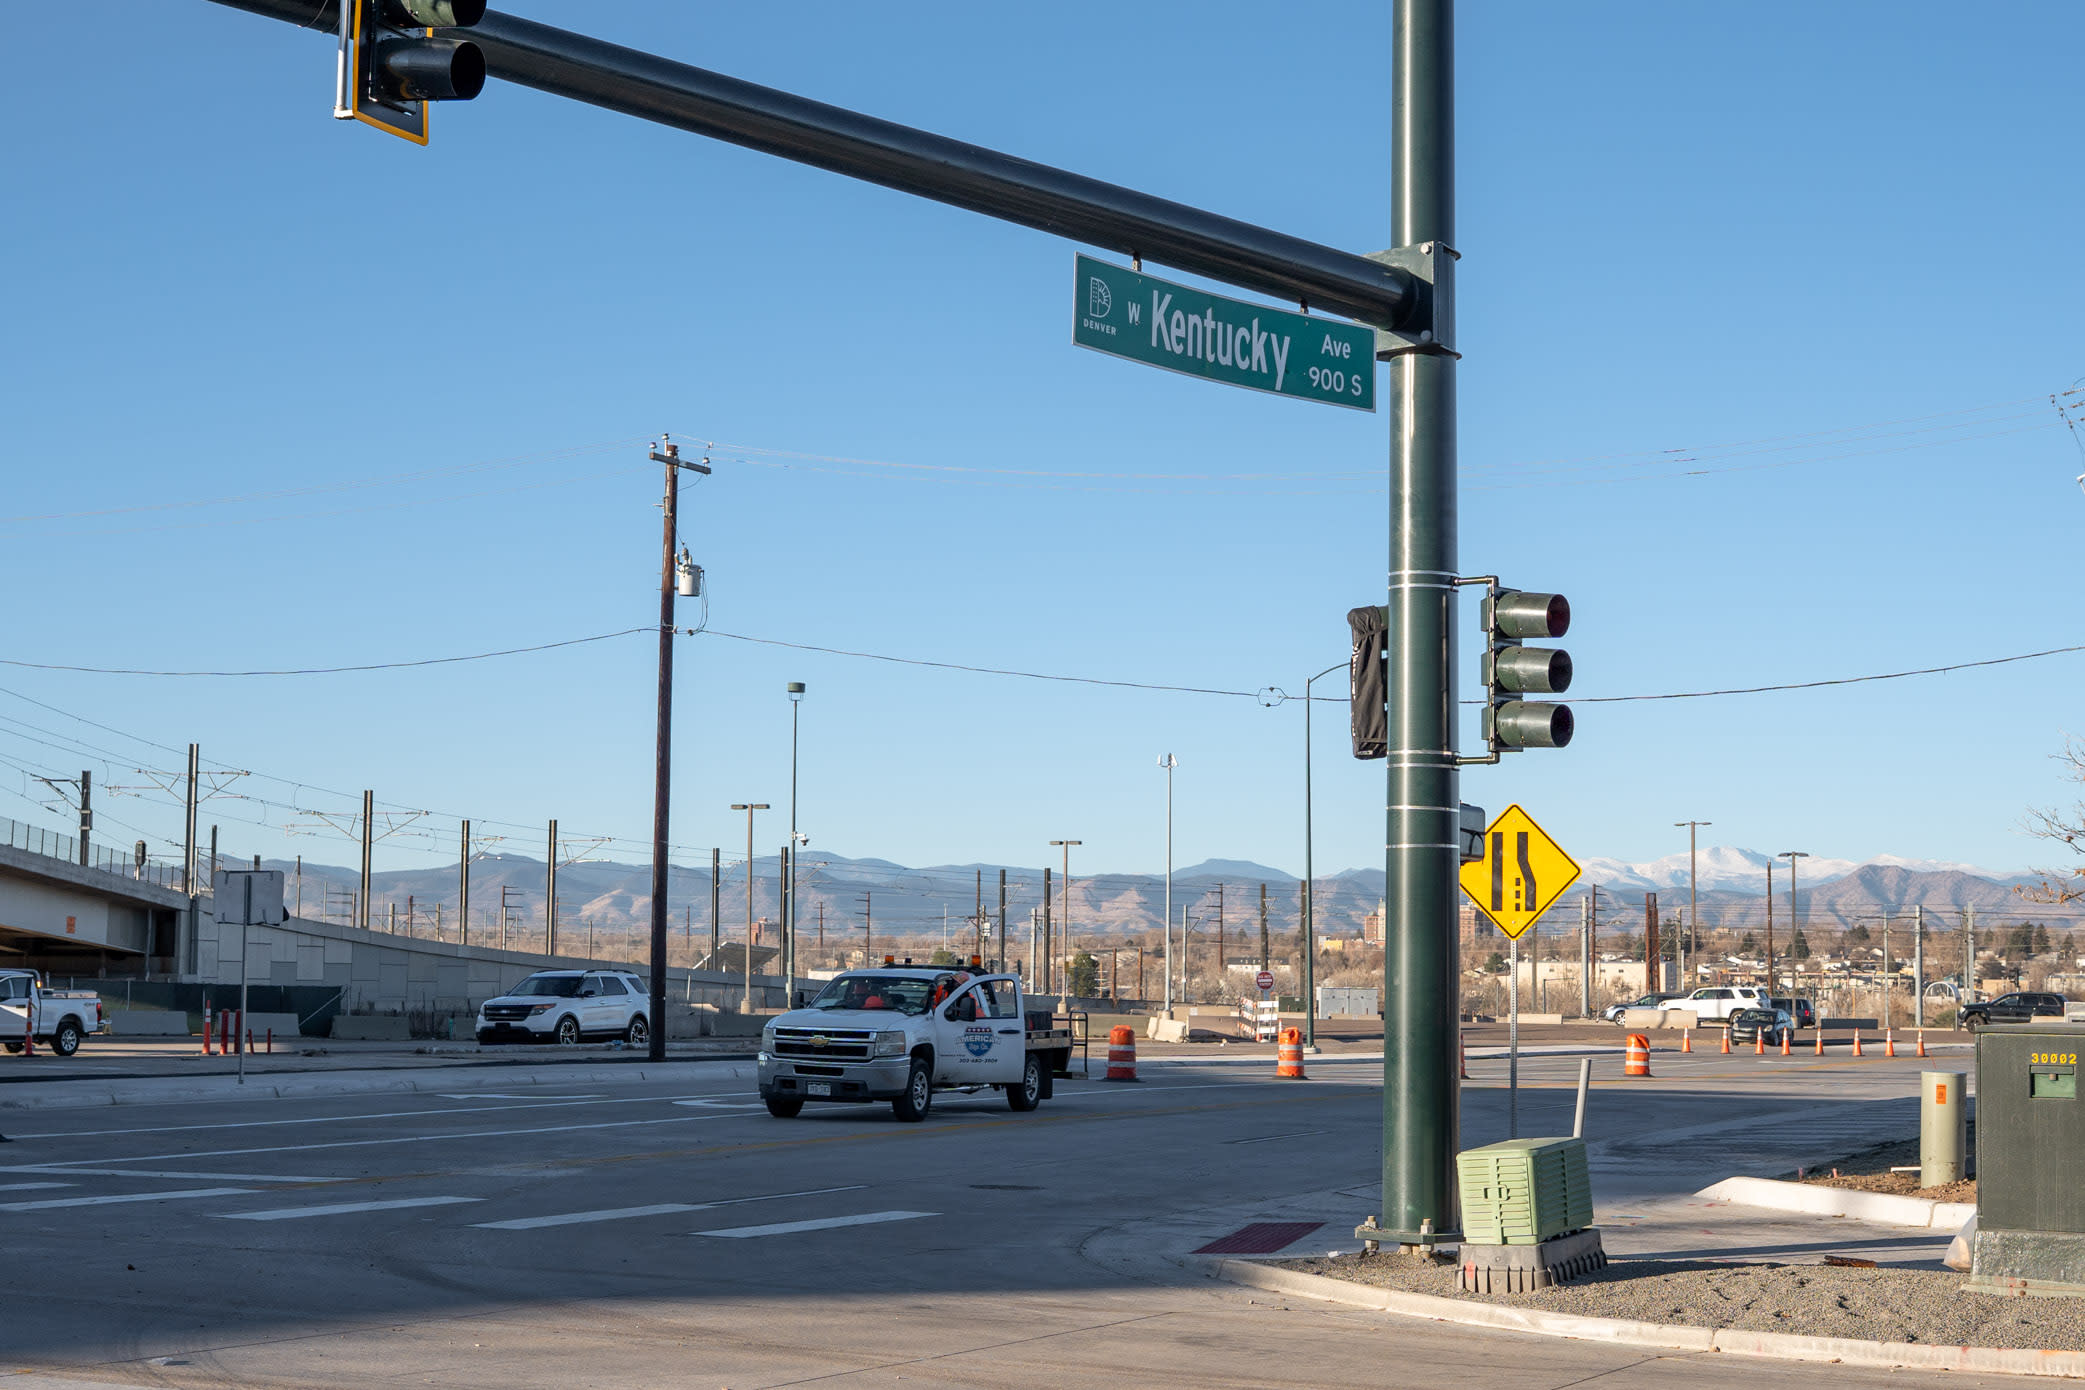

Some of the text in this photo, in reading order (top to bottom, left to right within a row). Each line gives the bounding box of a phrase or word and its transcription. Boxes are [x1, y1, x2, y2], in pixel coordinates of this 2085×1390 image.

[1083, 318, 1117, 336] DENVER
[1128, 290, 1351, 391] W Kentucky Ave
[1308, 366, 1362, 396] 900 S
[2031, 1052, 2077, 1064] 30002
